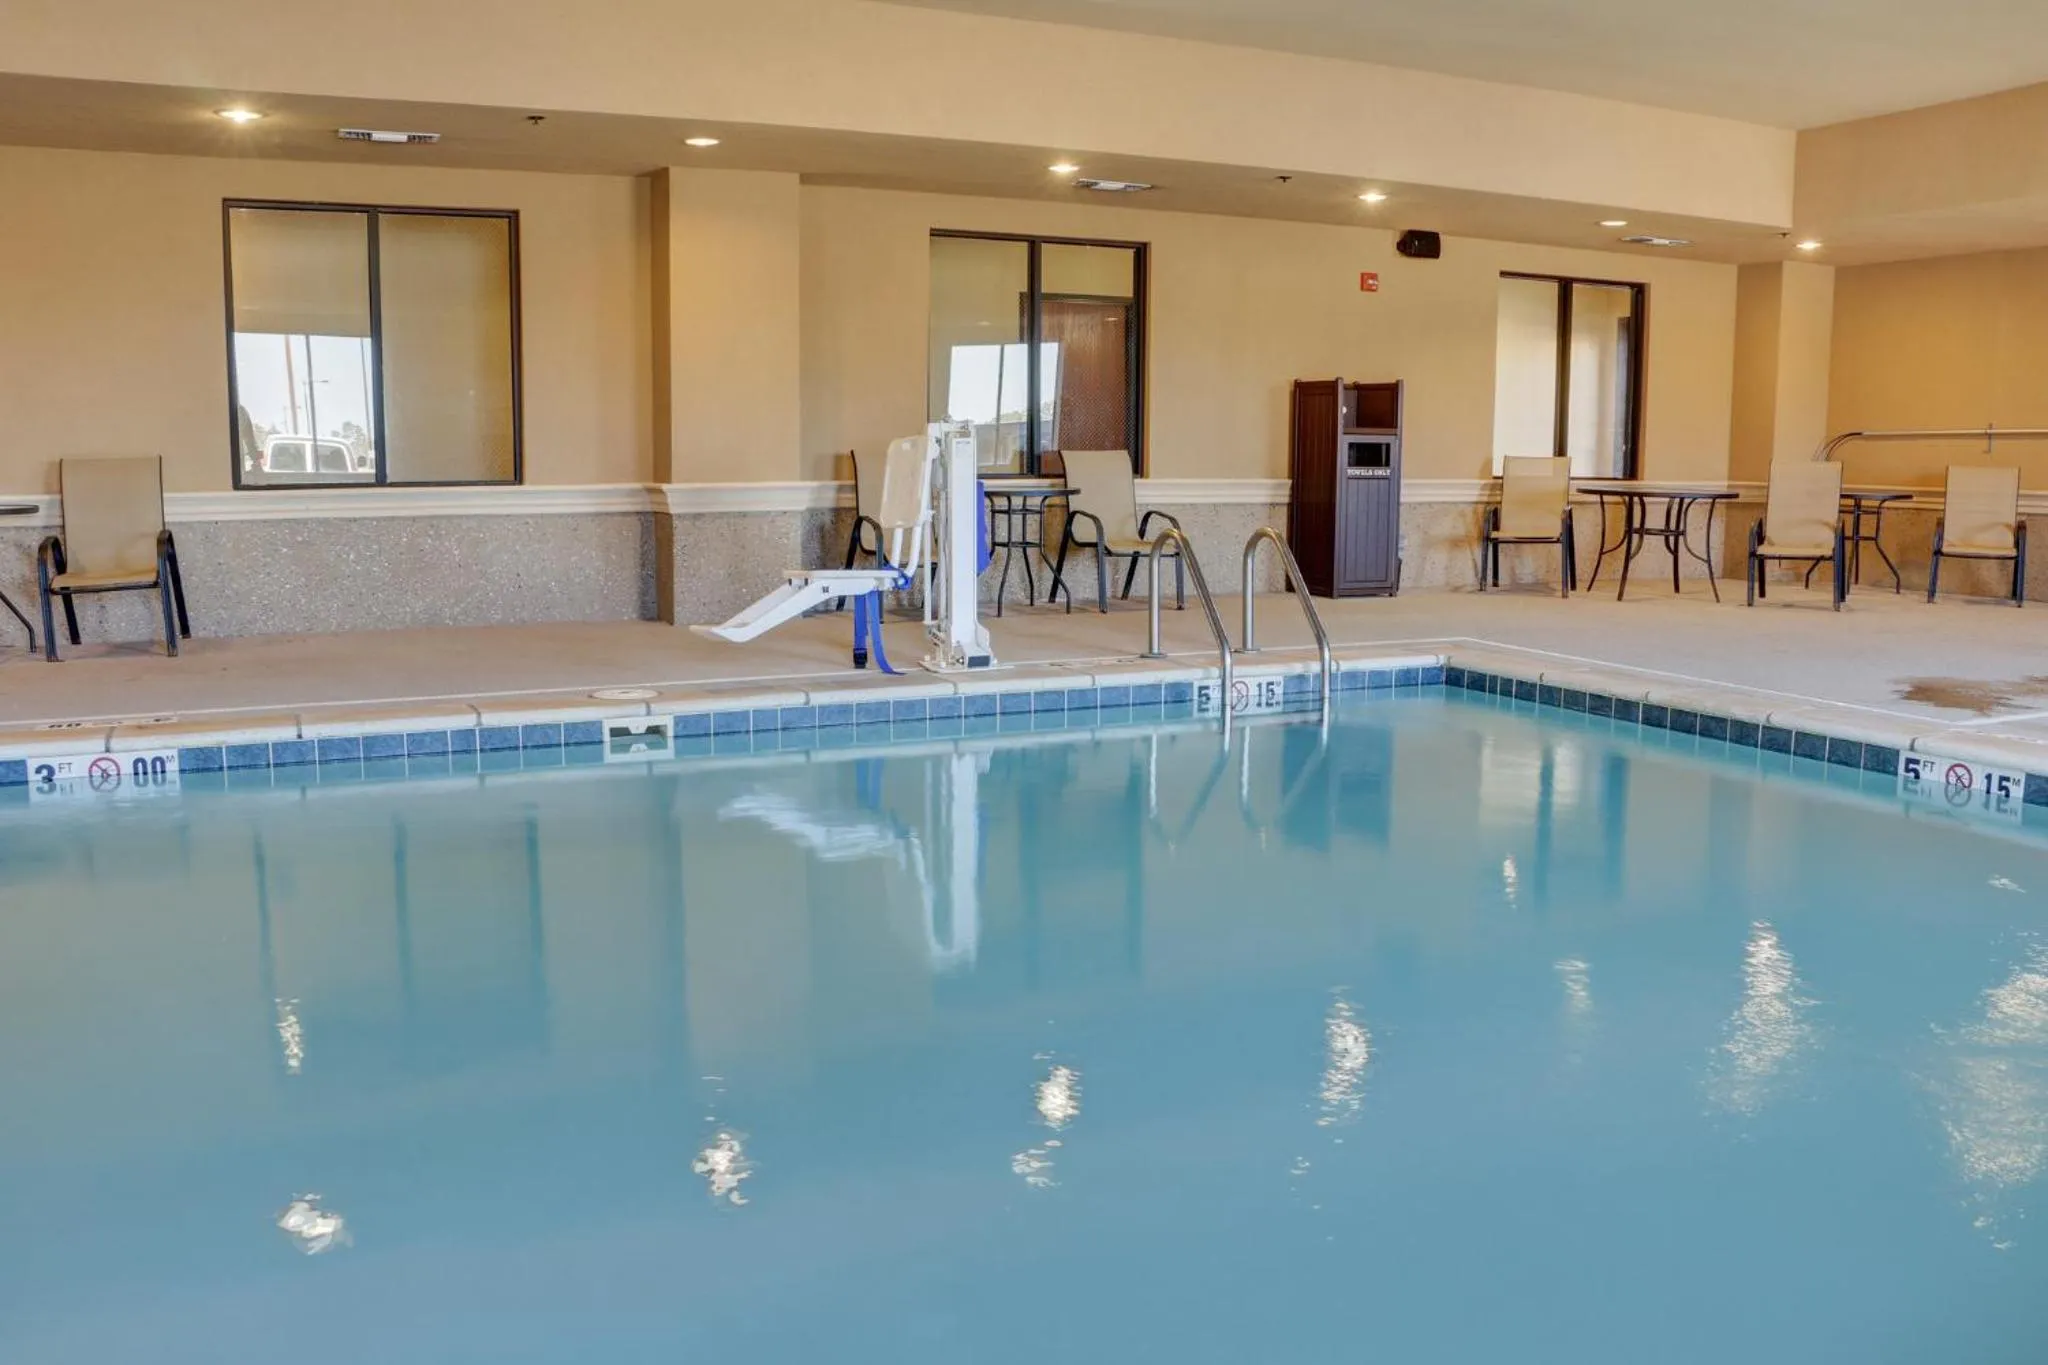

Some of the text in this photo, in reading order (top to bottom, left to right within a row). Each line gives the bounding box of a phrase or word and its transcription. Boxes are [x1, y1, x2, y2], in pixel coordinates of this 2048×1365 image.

[1198, 685, 1211, 701] 5
[35, 762, 72, 783] 3 FT
[1904, 757, 1936, 780] 5 FT
[2012, 777, 2021, 787] M
